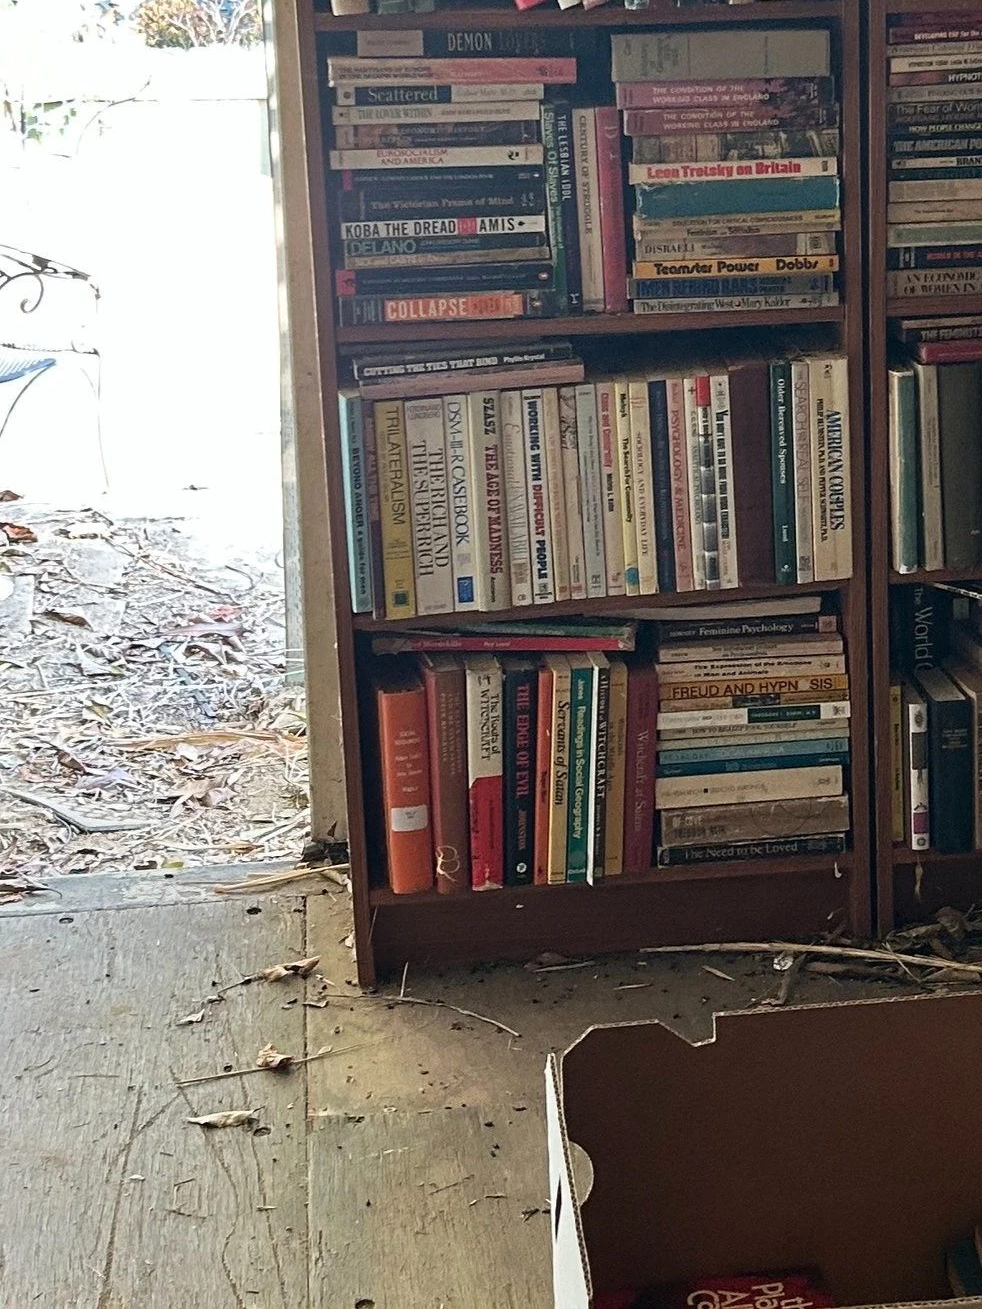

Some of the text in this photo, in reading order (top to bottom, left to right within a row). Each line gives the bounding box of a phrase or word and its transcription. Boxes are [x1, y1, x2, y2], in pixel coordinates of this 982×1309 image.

[447, 33, 492, 52] DEMON
[367, 85, 438, 103] Scattered
[917, 103, 940, 114] Fear
[647, 165, 680, 180] Leon
[755, 161, 801, 175] Britain
[345, 218, 515, 238] KOBA THE DREAD AMIS
[349, 240, 417, 255] DELANO
[644, 243, 695, 254] DISRAELI
[654, 258, 819, 276] Teamster Power Dobbs
[386, 298, 467, 320] COLLAPSE
[363, 365, 405, 376] CUTTING
[526, 401, 539, 451] WORKING
[386, 406, 407, 525] TRILATERALISM
[532, 454, 541, 481] WITH
[826, 409, 845, 531] AMERICAN COUPLES
[483, 398, 503, 574] SZASZ THE AGE OF MADNESS
[451, 467, 469, 546] CASEBOOK
[535, 539, 547, 579] PEOPLE
[699, 623, 794, 635] Feminine Psychology
[706, 846, 734, 857] Need
[766, 842, 798, 853] Loved
